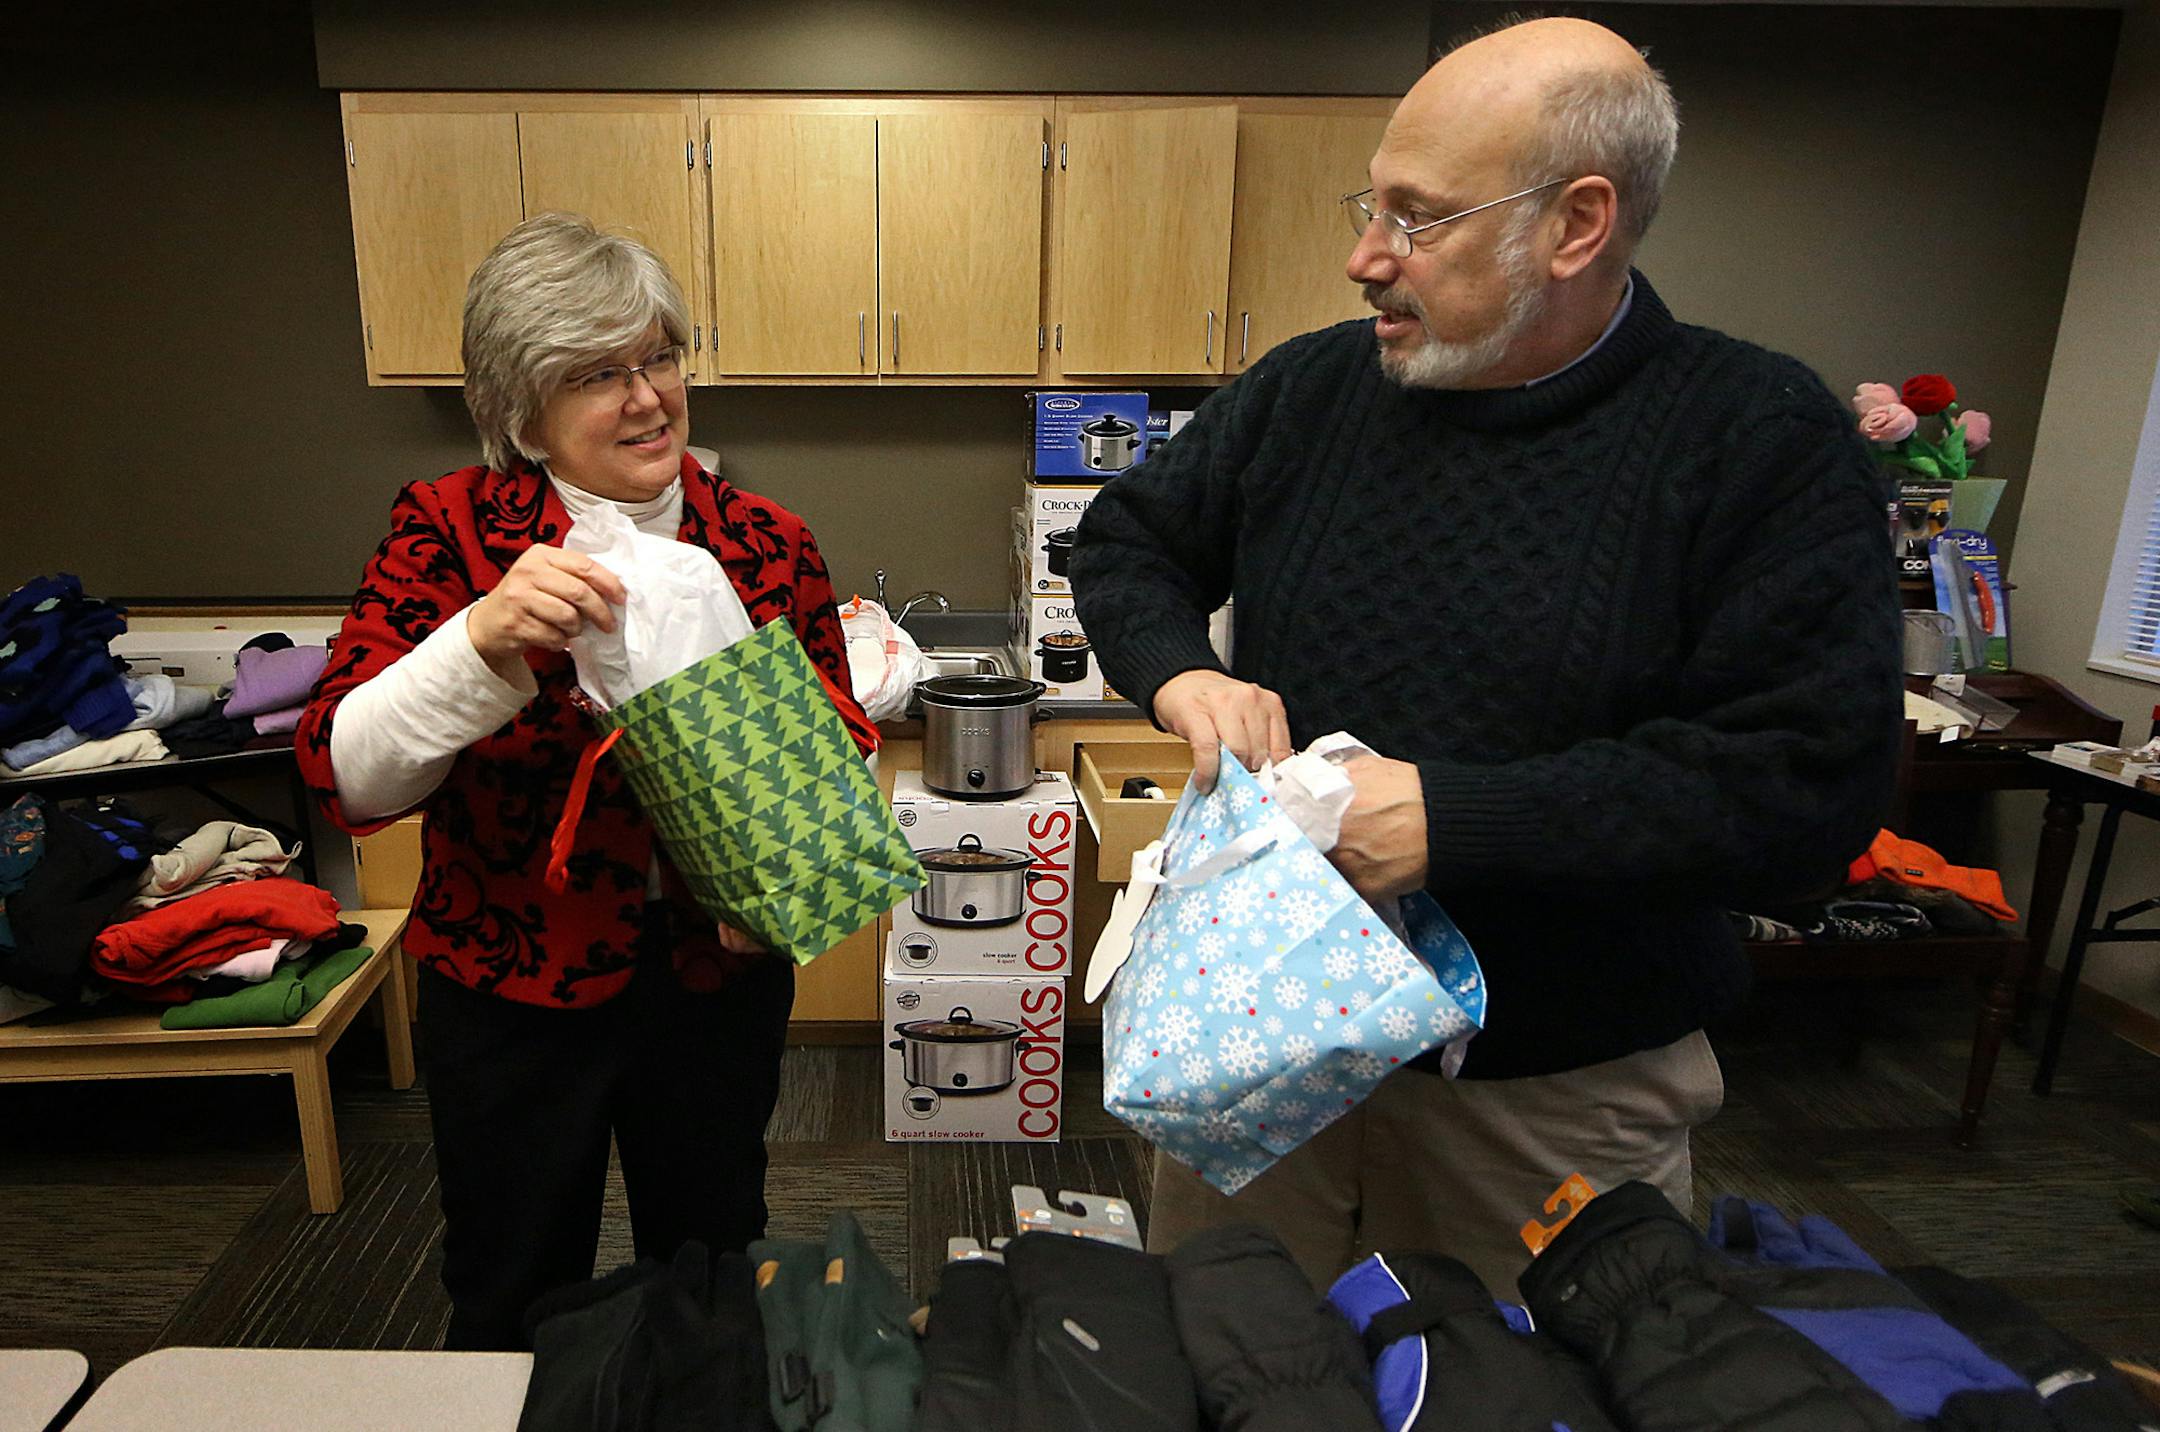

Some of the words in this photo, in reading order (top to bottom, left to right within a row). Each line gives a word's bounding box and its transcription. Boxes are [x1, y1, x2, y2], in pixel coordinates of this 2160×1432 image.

[1025, 810, 1071, 972] COOKS
[891, 1130, 898, 1138] 6
[900, 1130, 926, 1138] quart
[928, 1129, 950, 1138] slow
[952, 1129, 985, 1138] cooker
[1017, 986, 1063, 1138] COOKS
